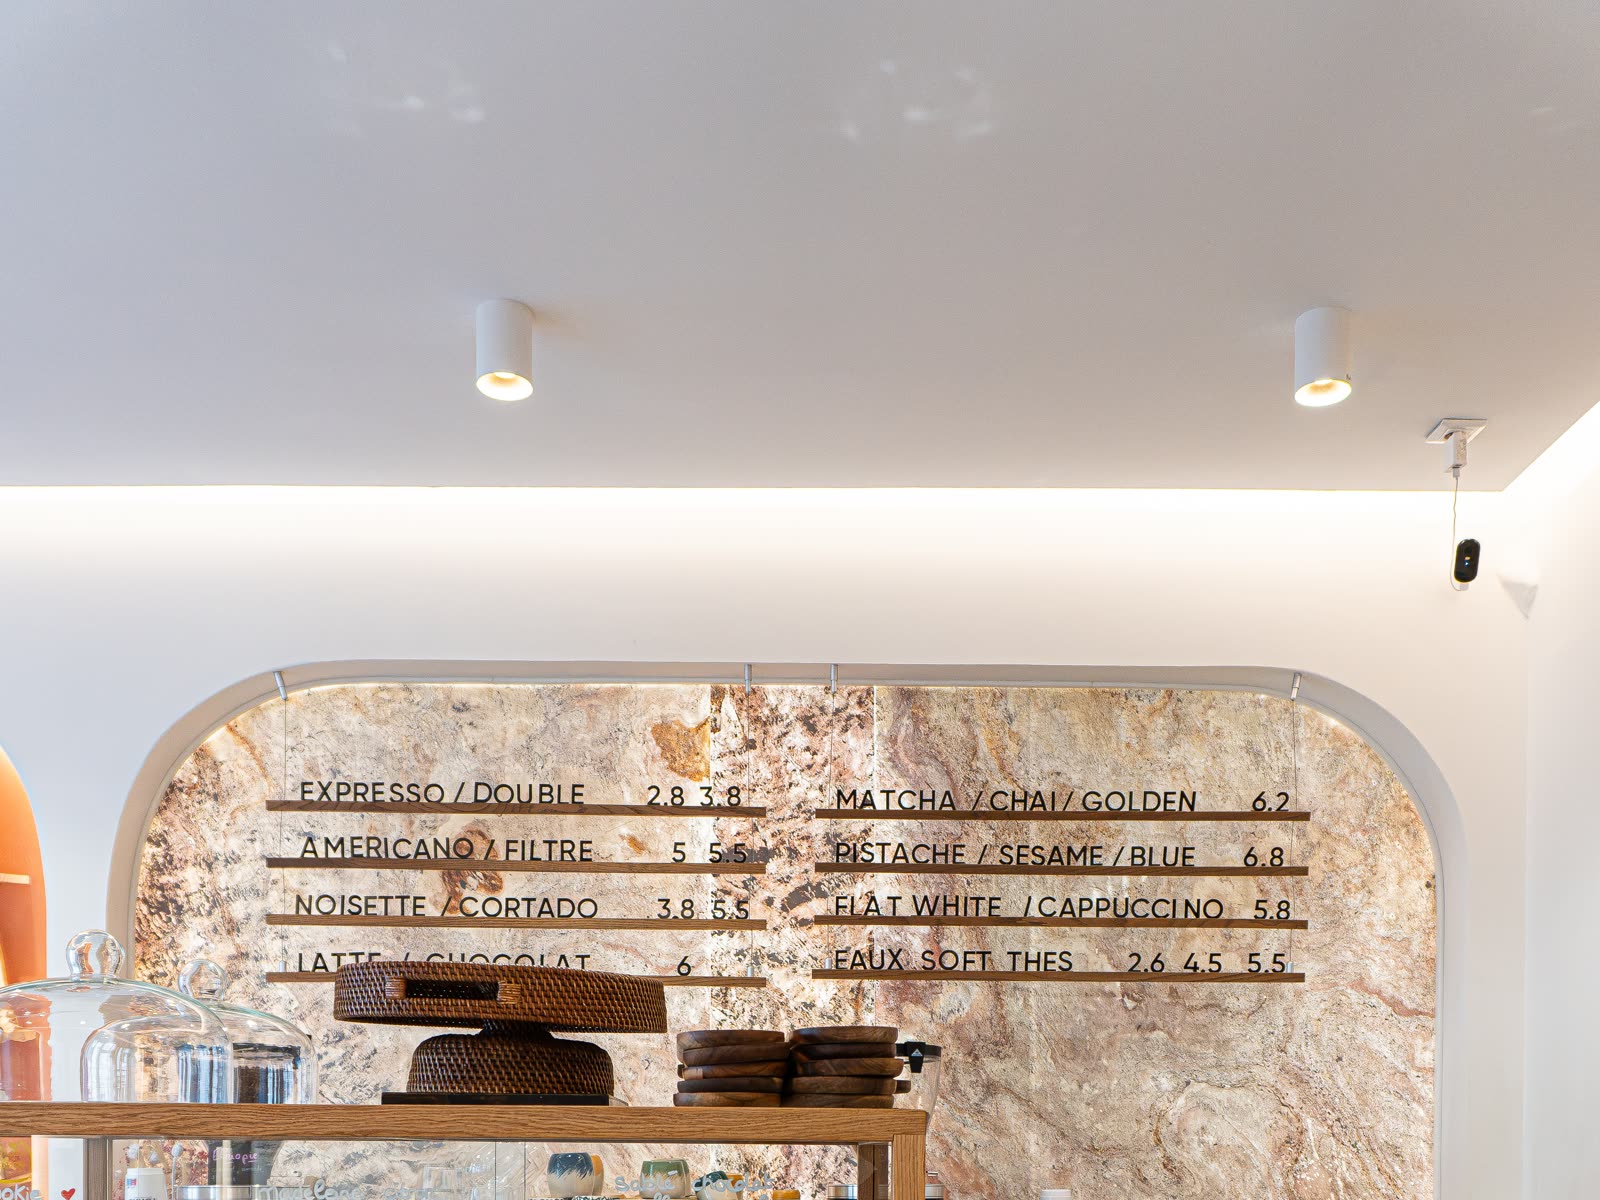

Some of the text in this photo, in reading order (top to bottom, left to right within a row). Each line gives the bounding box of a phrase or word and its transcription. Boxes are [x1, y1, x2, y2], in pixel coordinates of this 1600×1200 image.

[300, 782, 444, 804] EXPRESSO
[474, 782, 586, 806] DOUBLE
[647, 785, 742, 808] 2.8 3.8
[836, 789, 957, 811] MATCHA
[990, 791, 1056, 812] CHAI
[1082, 791, 1197, 812] GOLDEN
[1252, 791, 1291, 813] 6.2
[300, 836, 475, 861] AMERICANO
[505, 839, 594, 862] FILTRE
[672, 841, 748, 865] 5 5.5
[835, 843, 966, 865] PISTACHE
[999, 845, 1103, 867] SESAME
[1131, 846, 1196, 868] BLUE
[1243, 846, 1285, 868] 6.8
[295, 894, 427, 917] NOISETTE
[458, 896, 599, 920] CORTADO
[657, 898, 751, 920] 3.8 5.5
[835, 895, 903, 917] FLAT
[913, 895, 1002, 918] WHITE
[1039, 896, 1225, 920] CAPPUCCINO
[1253, 899, 1292, 921] 5.8
[678, 957, 692, 977] 6
[835, 949, 1073, 973] EAUX SOFT THES
[1128, 953, 1287, 974] 2.6 4.5 5.5
